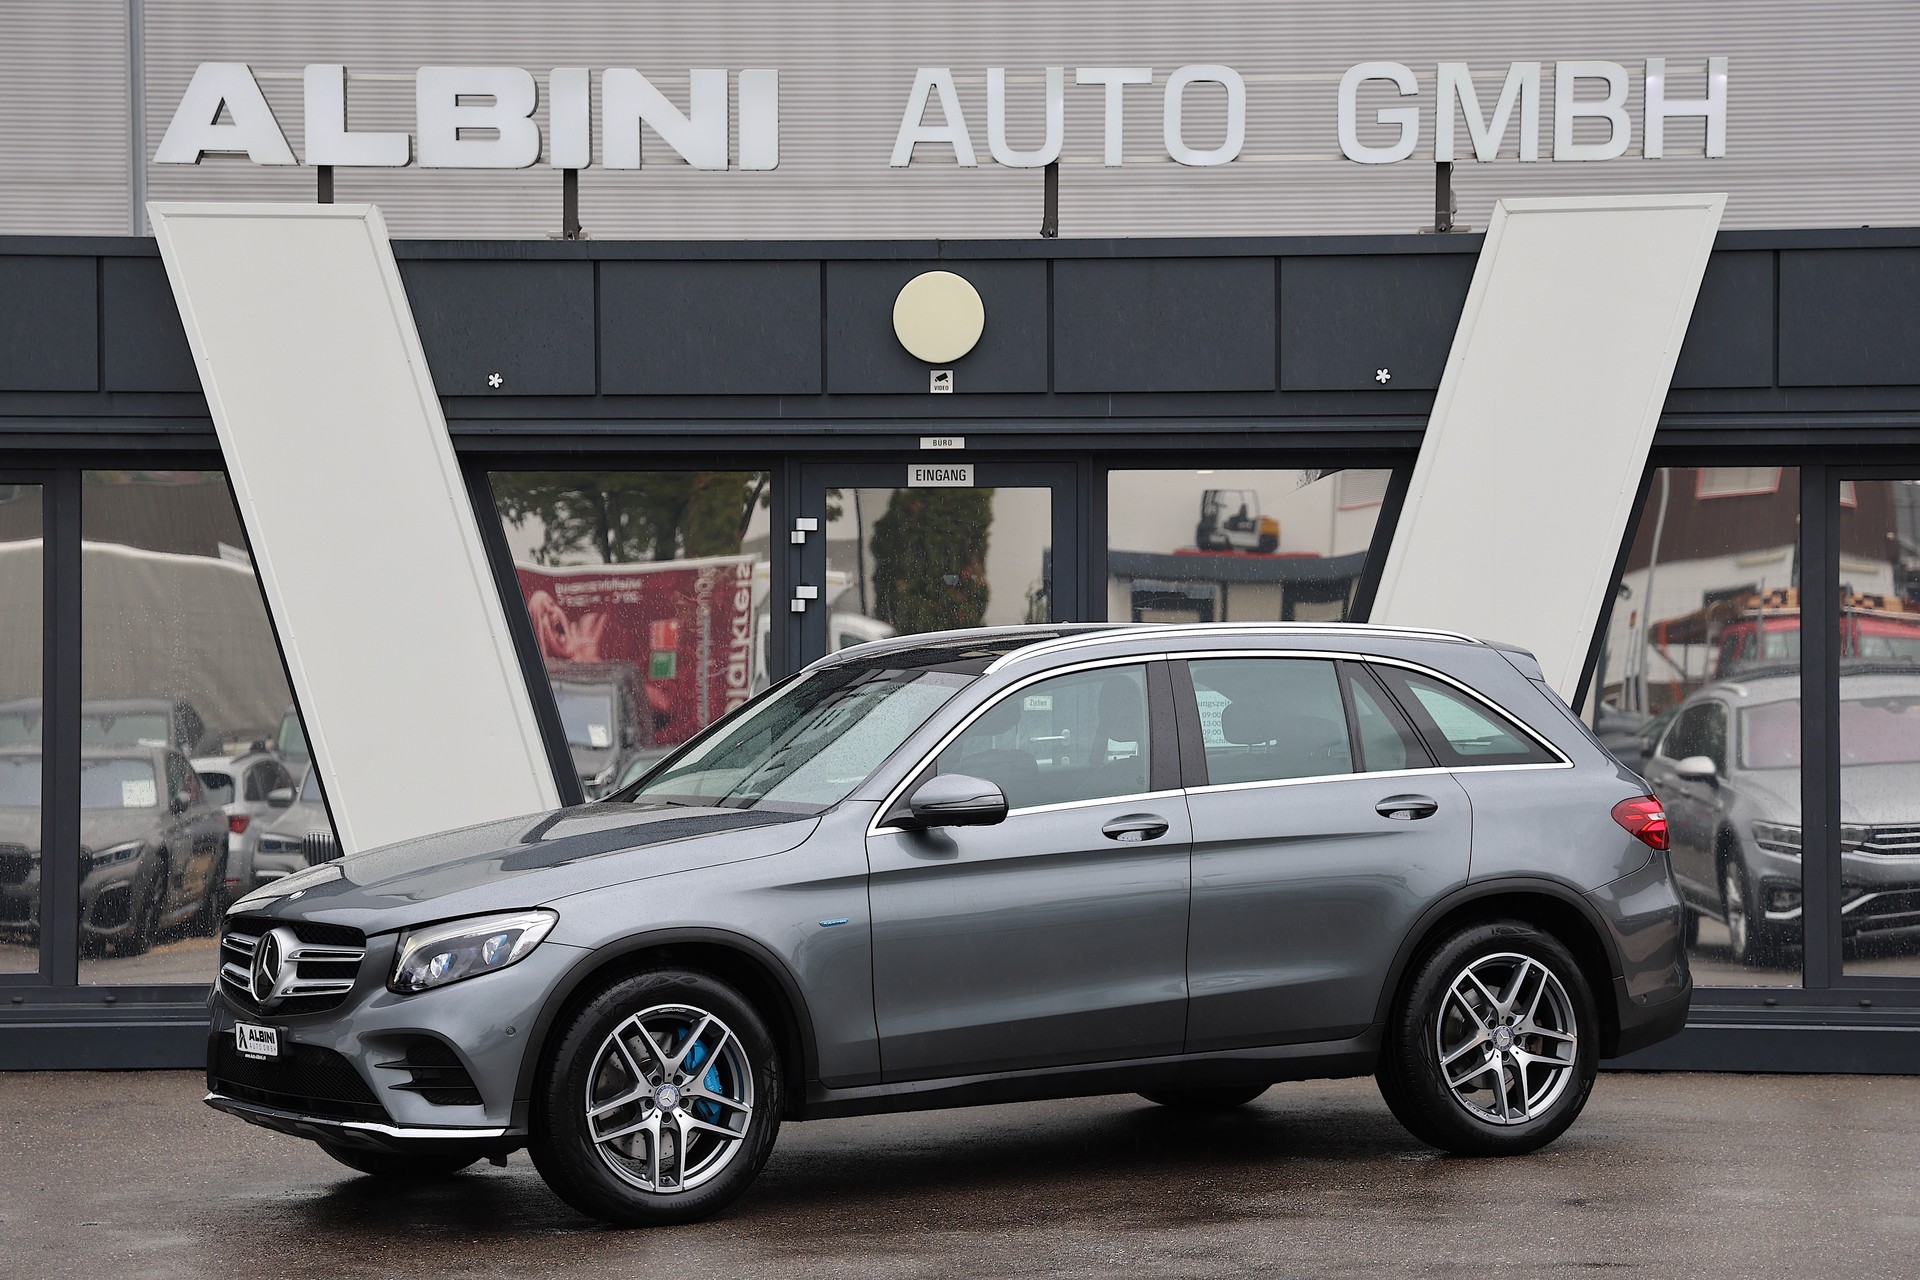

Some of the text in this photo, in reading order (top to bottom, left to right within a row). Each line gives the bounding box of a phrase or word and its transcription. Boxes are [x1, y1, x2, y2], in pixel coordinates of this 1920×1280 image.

[153, 57, 1729, 171] ALBINI AUTO GMBH
[932, 438, 953, 447] BÜRO
[915, 469, 967, 482] EINGANG
[249, 1028, 276, 1045] ALBINI
